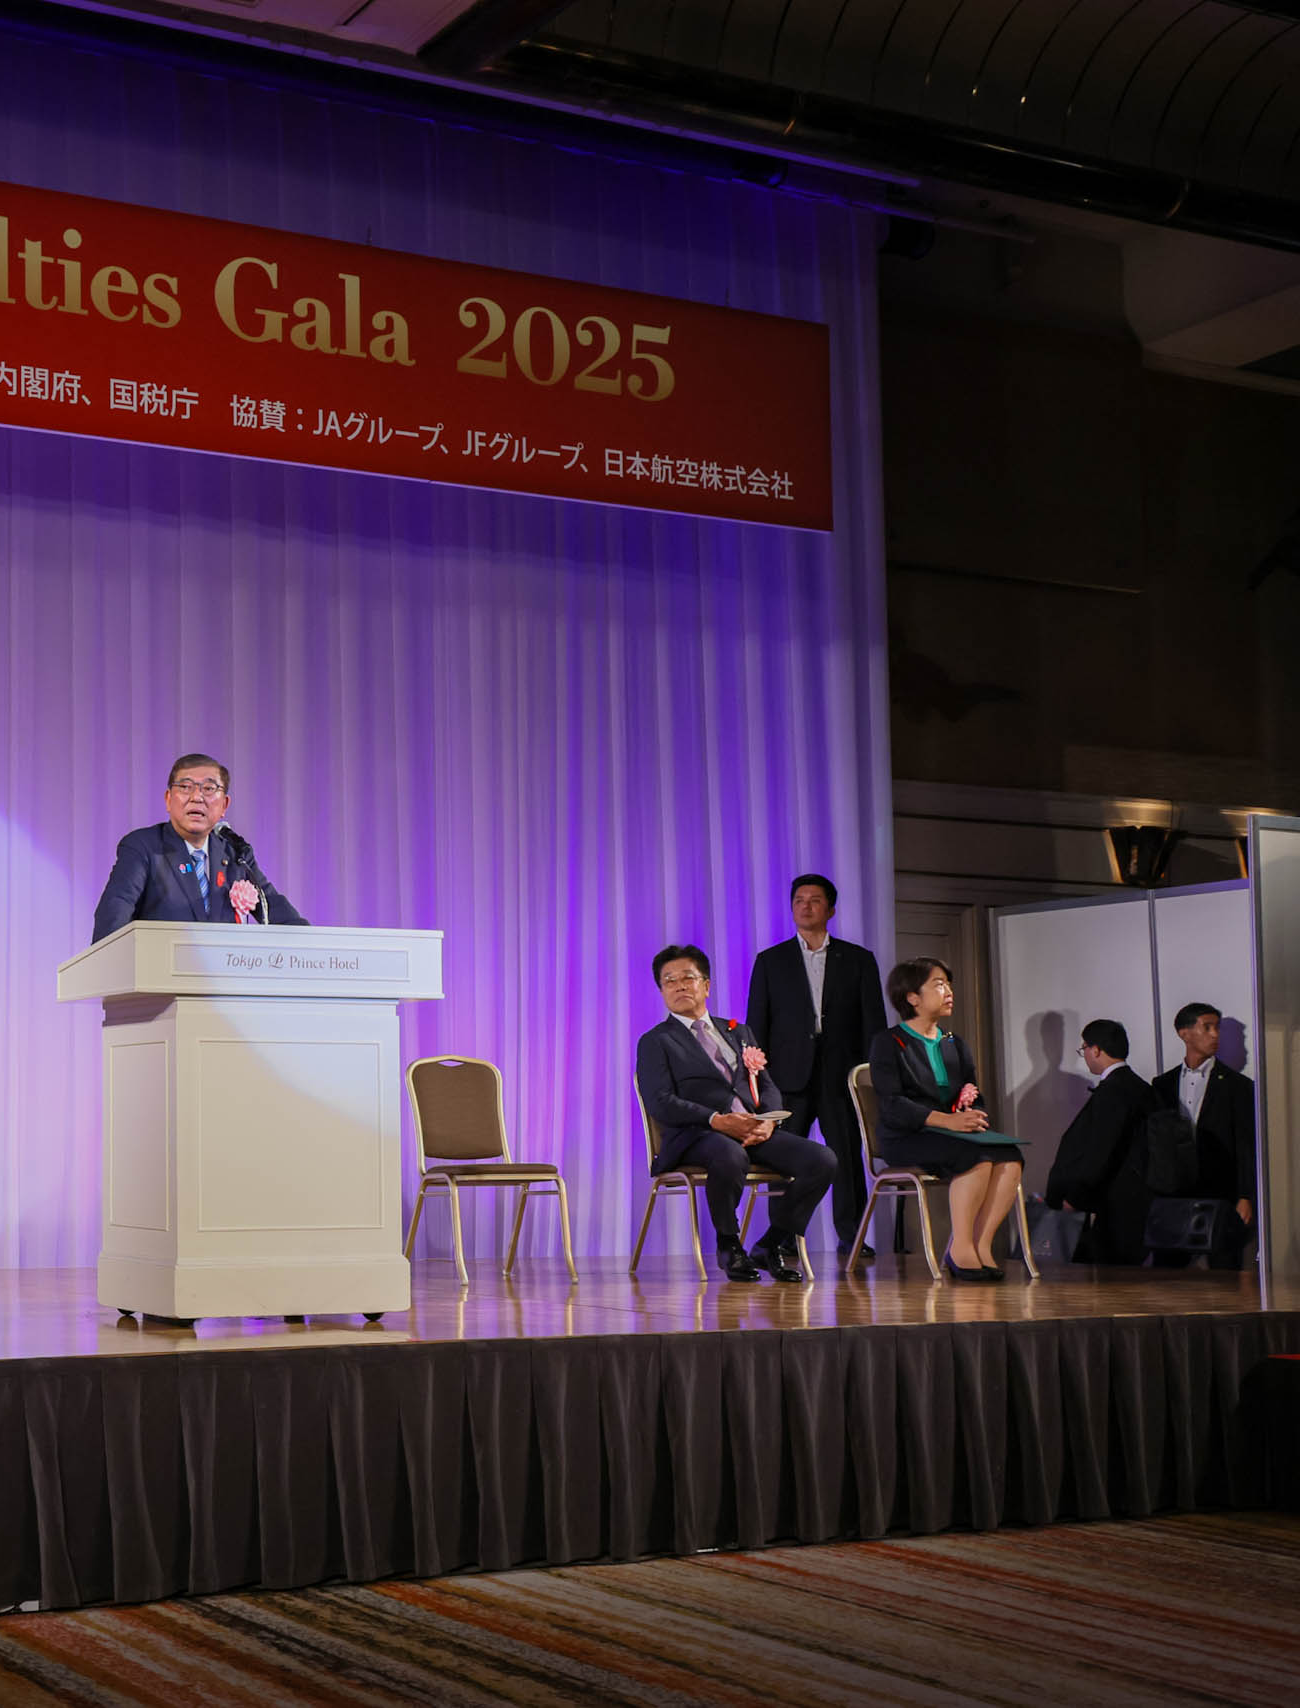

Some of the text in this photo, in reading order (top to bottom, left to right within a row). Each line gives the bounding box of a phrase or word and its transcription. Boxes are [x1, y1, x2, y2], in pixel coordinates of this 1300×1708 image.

[214, 256, 417, 368] Gala
[457, 297, 676, 402] 2025
[226, 953, 263, 970] Tokyo
[289, 955, 326, 969] Prince
[329, 956, 360, 970] Hotel
